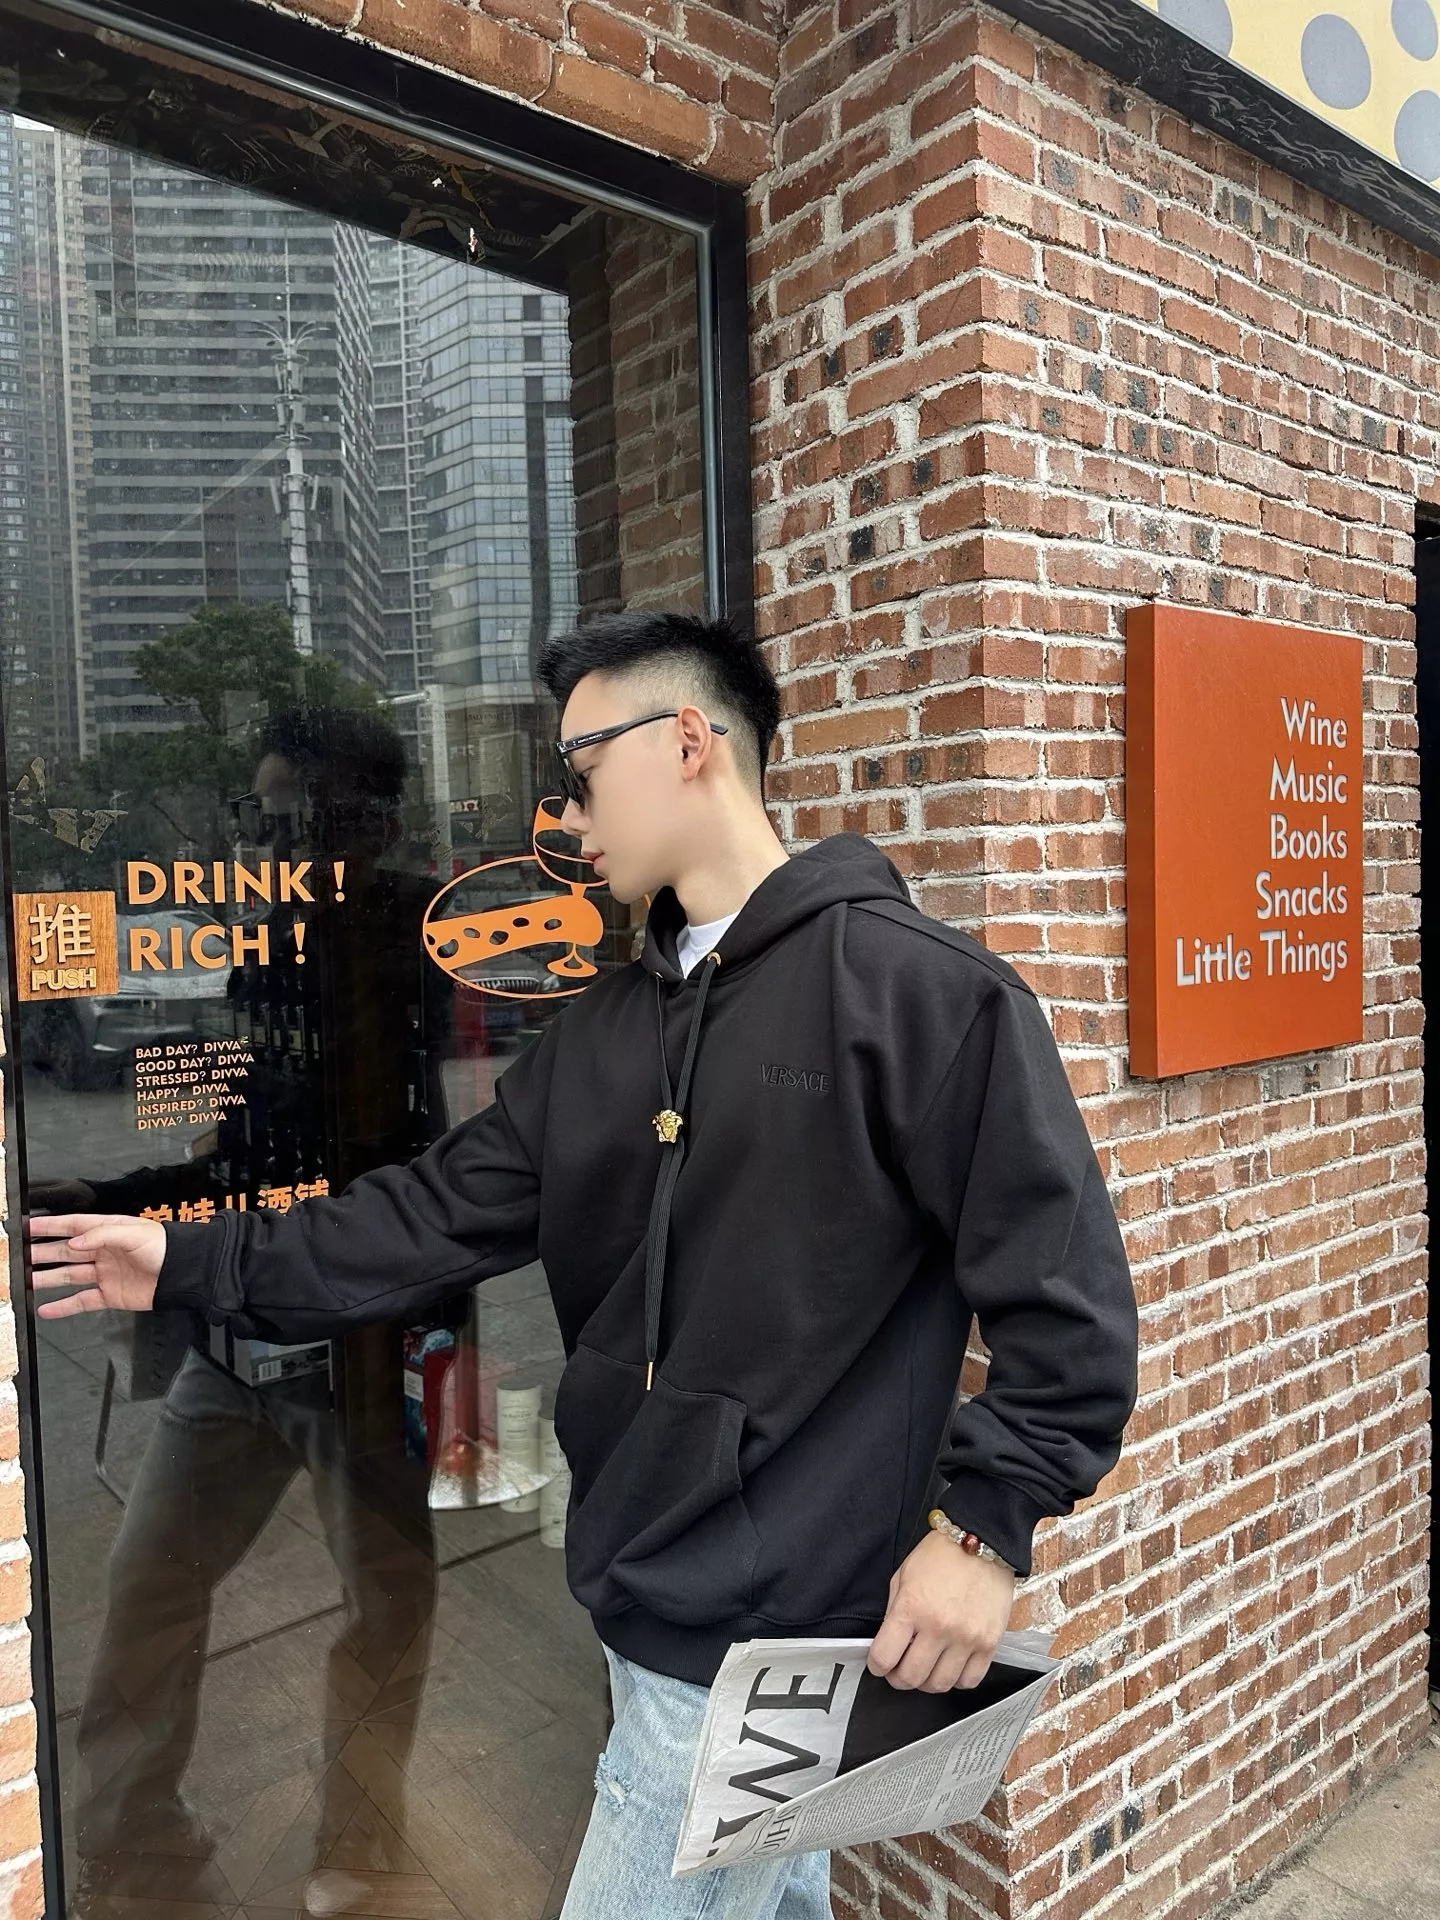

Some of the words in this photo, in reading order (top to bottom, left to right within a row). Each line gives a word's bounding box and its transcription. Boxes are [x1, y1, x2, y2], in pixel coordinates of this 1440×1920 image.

[1280, 696, 1348, 749] Wine
[1269, 755, 1348, 804] Music
[1270, 813, 1348, 861] Books
[1255, 870, 1348, 921] Snacks
[30, 902, 95, 964] 推
[1176, 933, 1252, 987] Little
[1259, 929, 1348, 983] Things
[31, 967, 97, 991] PUSH
[135, 1047, 162, 1059] BAD
[166, 1044, 198, 1056] DAY?
[204, 1040, 241, 1053] DIVVA
[135, 1060, 176, 1073] GOOD
[180, 1057, 212, 1069] DAY?
[218, 1053, 255, 1066] DIVVA
[136, 1070, 206, 1088] STRESSED?
[211, 1067, 248, 1080] DIVVA
[760, 1063, 832, 1093] VERSACE
[136, 1088, 184, 1101] HAPPY
[192, 1083, 230, 1096] DIVVA
[136, 1099, 203, 1116] INSPIRED?
[209, 1095, 247, 1108] DIVVA
[137, 1116, 183, 1131] DIVVA?
[189, 1111, 227, 1124] DIVVA
